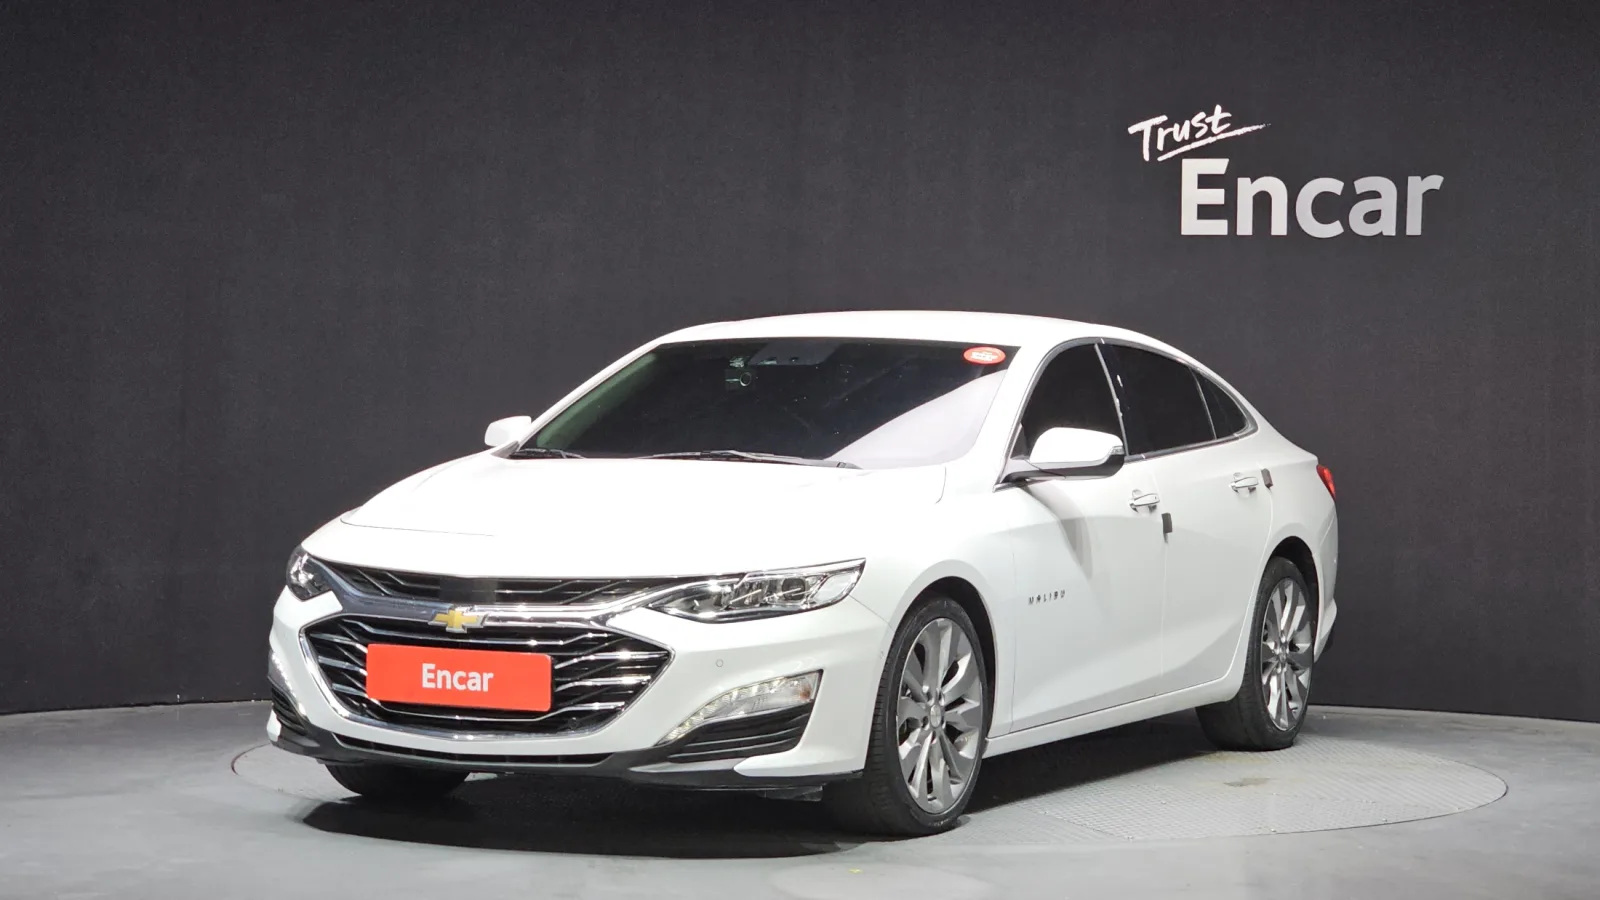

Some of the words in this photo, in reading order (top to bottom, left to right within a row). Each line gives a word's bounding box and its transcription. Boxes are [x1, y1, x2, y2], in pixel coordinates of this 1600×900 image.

[1128, 104, 1232, 162] Trust
[1180, 158, 1444, 239] Encar
[421, 663, 494, 692] Encar
